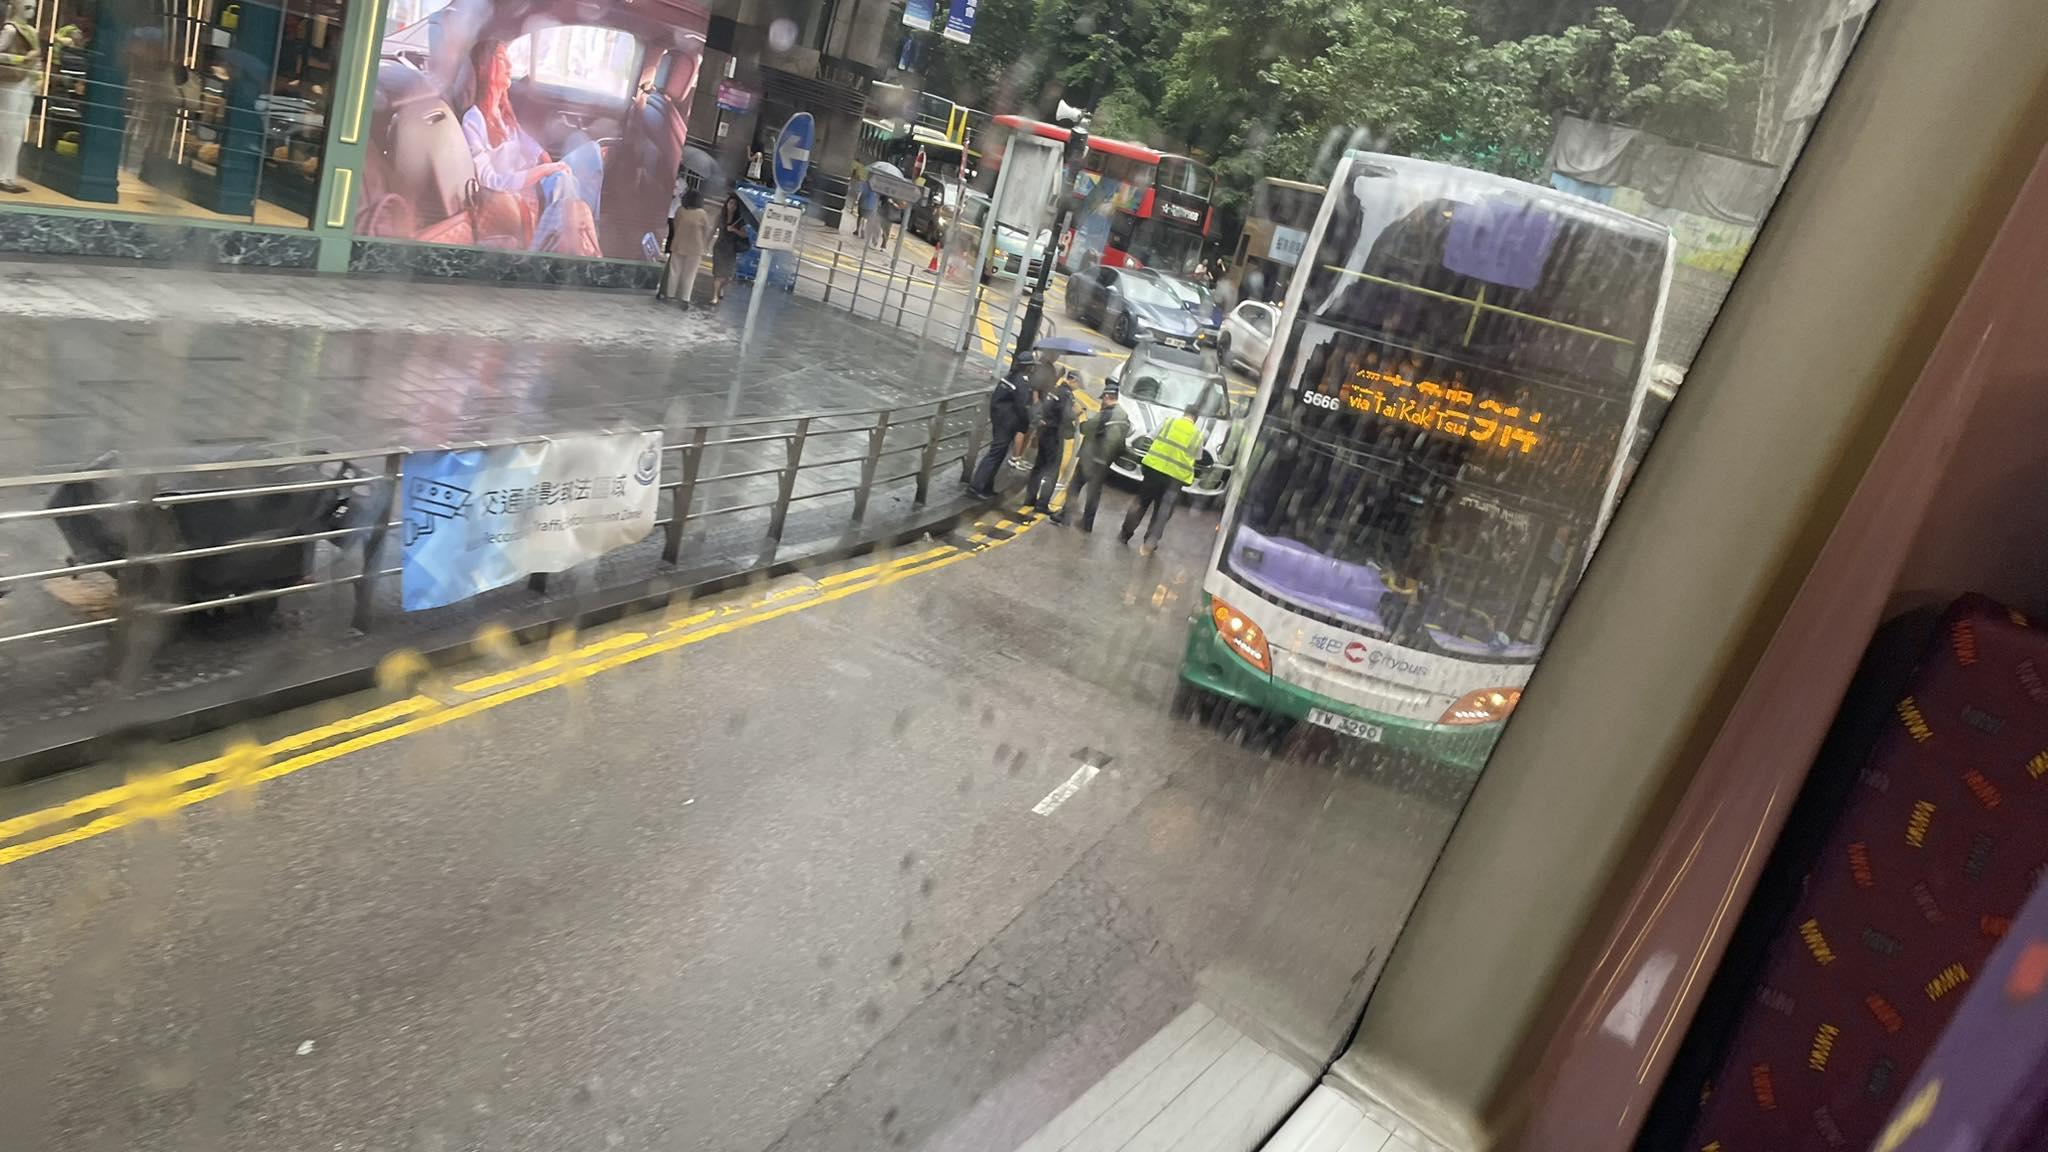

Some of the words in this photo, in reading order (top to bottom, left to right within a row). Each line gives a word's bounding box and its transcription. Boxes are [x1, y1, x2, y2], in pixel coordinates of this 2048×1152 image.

[1303, 390, 1340, 411] 5666
[1349, 394, 1370, 411] via
[1375, 394, 1396, 417] Tai
[1399, 399, 1431, 428] Kok
[1436, 411, 1467, 437] Tsui
